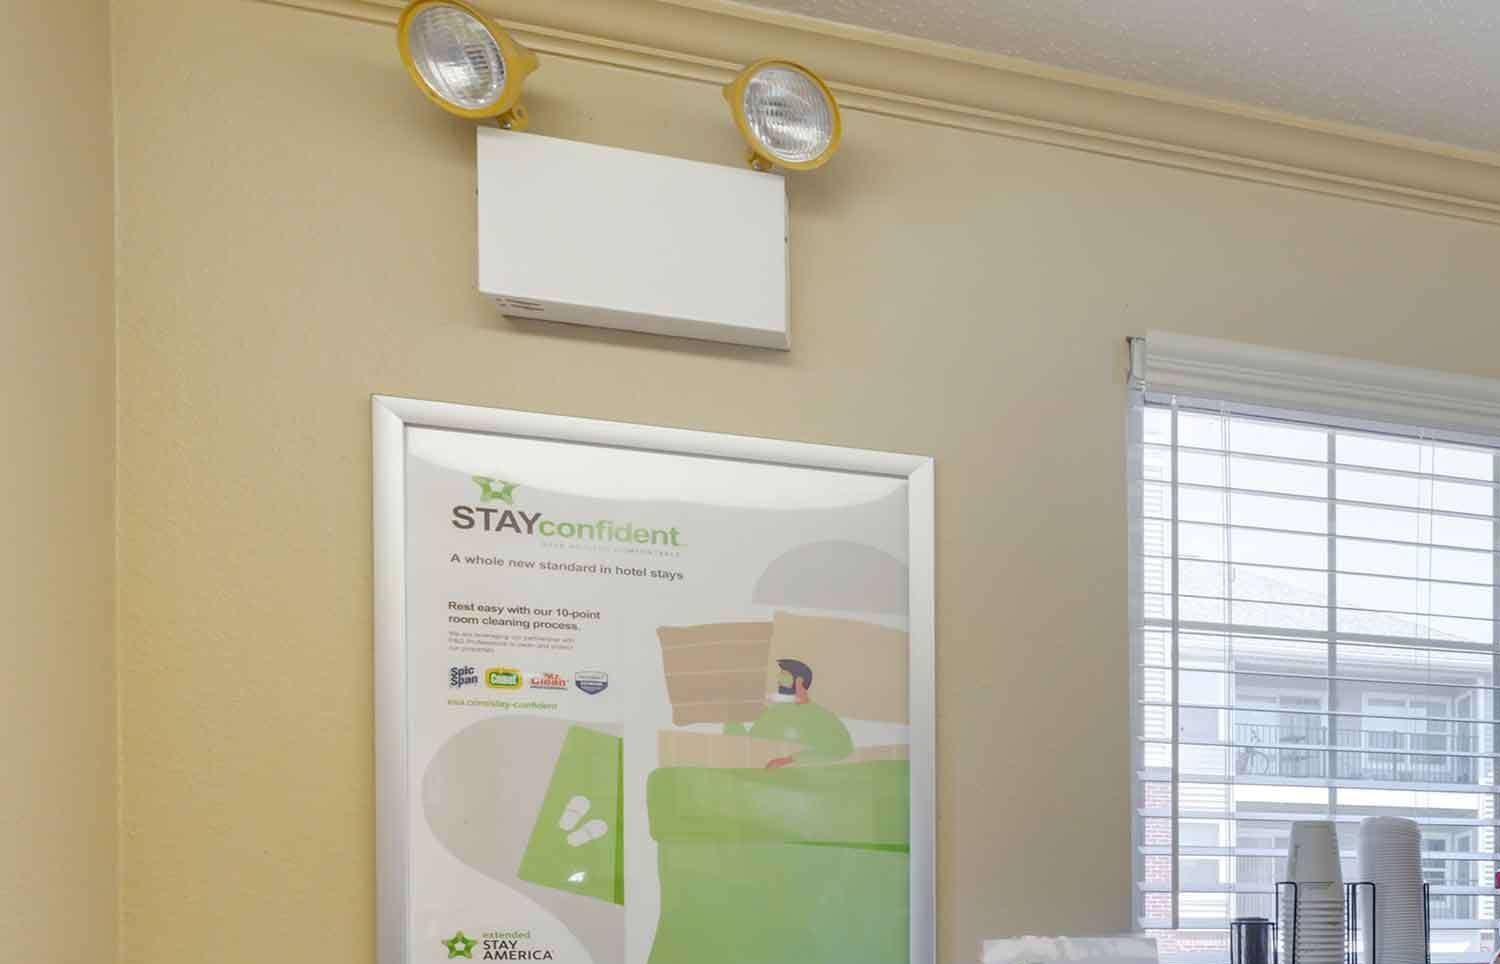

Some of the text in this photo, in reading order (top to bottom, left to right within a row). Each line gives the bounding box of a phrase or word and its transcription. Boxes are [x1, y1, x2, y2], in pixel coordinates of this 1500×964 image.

[450, 553, 684, 581] A whole new standard in hotel stays
[448, 601, 601, 620] Rest easy with our 10-point
[448, 615, 479, 625] room
[482, 616, 530, 629] cleaning
[450, 665, 475, 679] Spic
[450, 674, 478, 688] Span
[482, 930, 530, 939] extended
[482, 940, 518, 950] STAY
[482, 951, 553, 960] AMERICA
